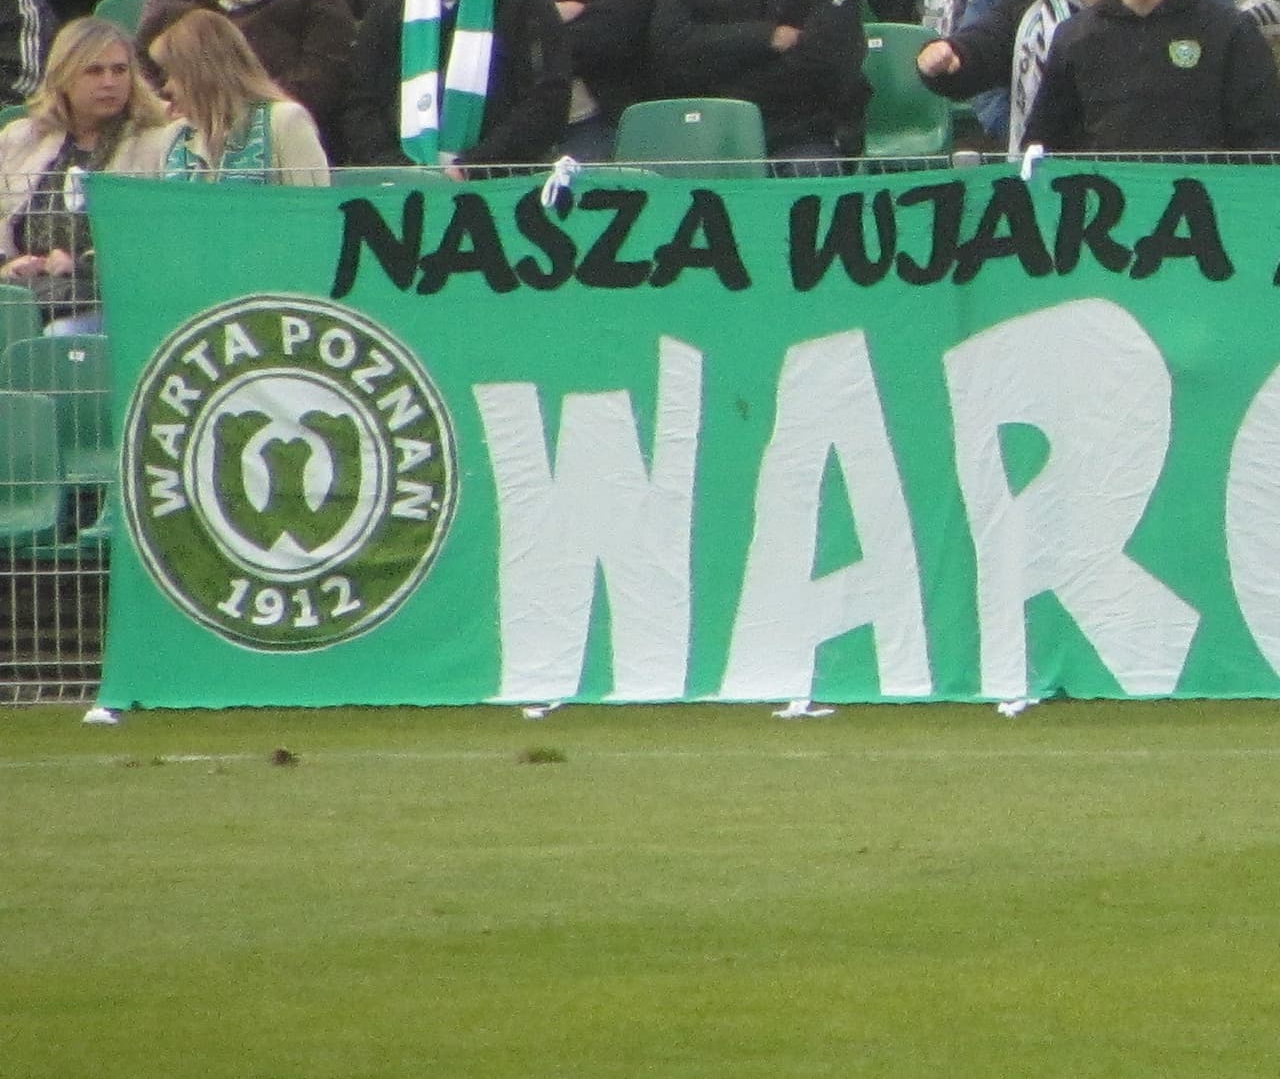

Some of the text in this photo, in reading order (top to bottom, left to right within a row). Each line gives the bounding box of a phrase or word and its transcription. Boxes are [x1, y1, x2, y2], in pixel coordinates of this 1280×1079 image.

[331, 188, 750, 298] NASZA
[144, 316, 438, 521] WARTA POZNAŃ
[217, 576, 362, 627] 1912
